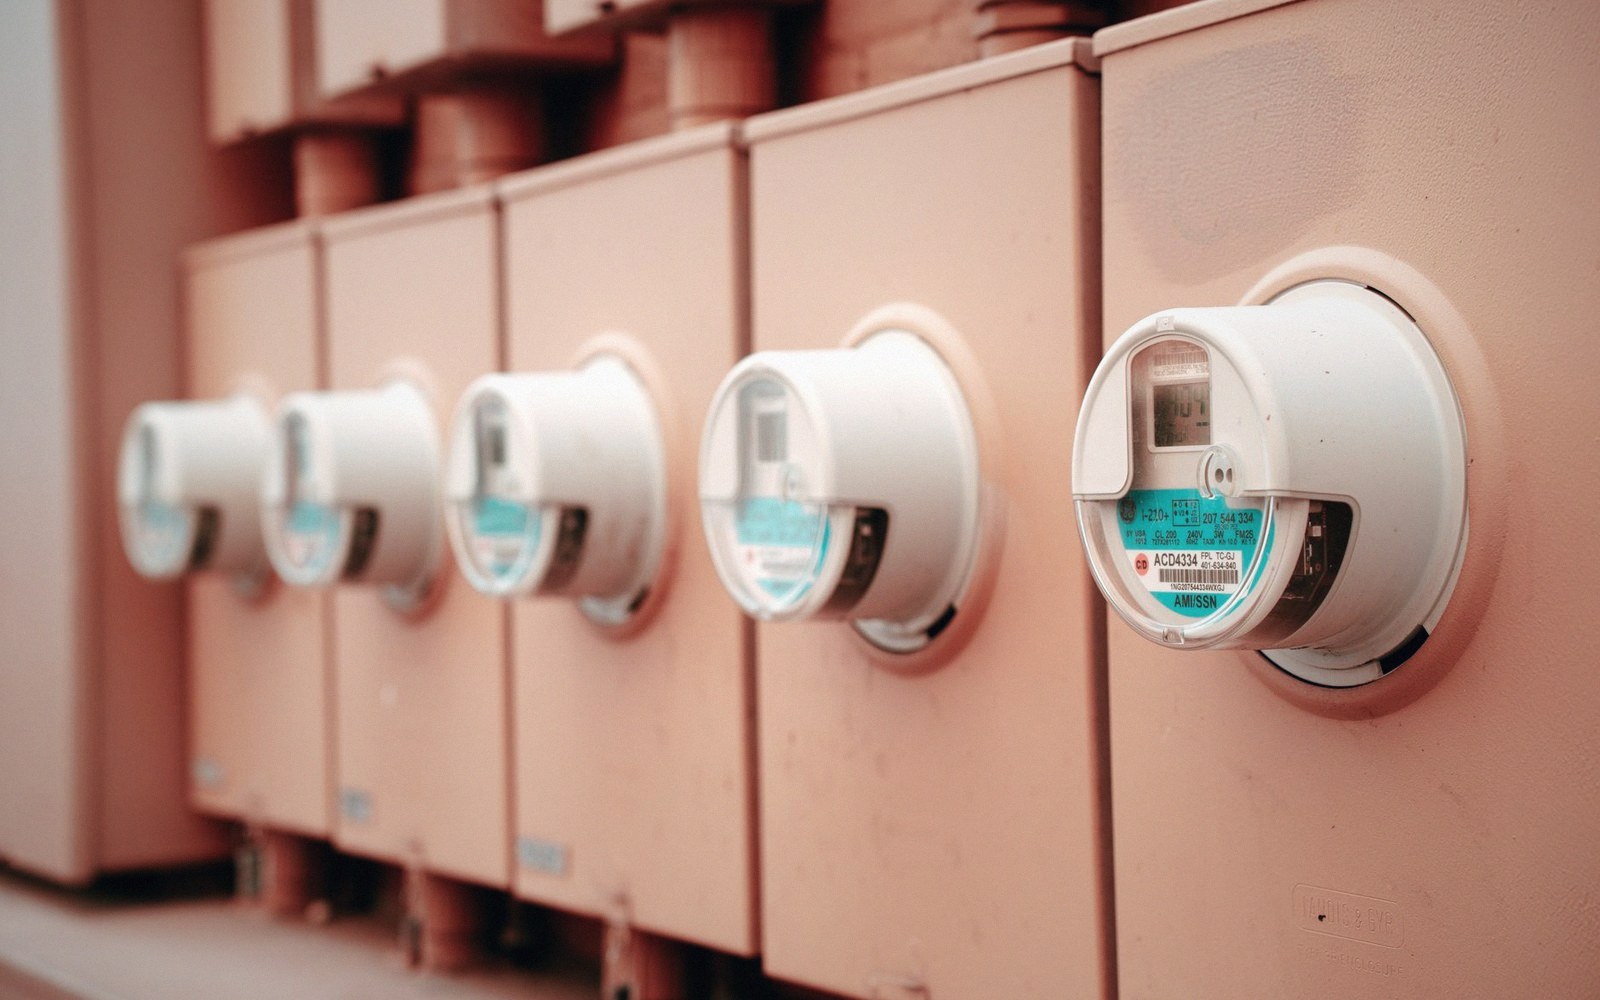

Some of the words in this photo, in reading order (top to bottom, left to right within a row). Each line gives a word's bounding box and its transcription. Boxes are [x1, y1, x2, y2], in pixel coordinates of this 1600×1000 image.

[1203, 512, 1217, 524] 207
[1220, 512, 1236, 524] 544
[1238, 512, 1254, 524] 334
[1155, 530, 1164, 539] CL
[1166, 530, 1177, 539] 200
[1187, 530, 1204, 539] 240V
[1214, 530, 1225, 539] 3W
[1235, 530, 1254, 539] FM2S
[1154, 553, 1198, 567] ACD4334
[1201, 552, 1212, 560] FPL
[1216, 552, 1235, 560] TC-GJ
[1201, 561, 1237, 570] 401-634-840
[1174, 594, 1217, 609] AMI/SSN
[1355, 908, 1363, 929] &
